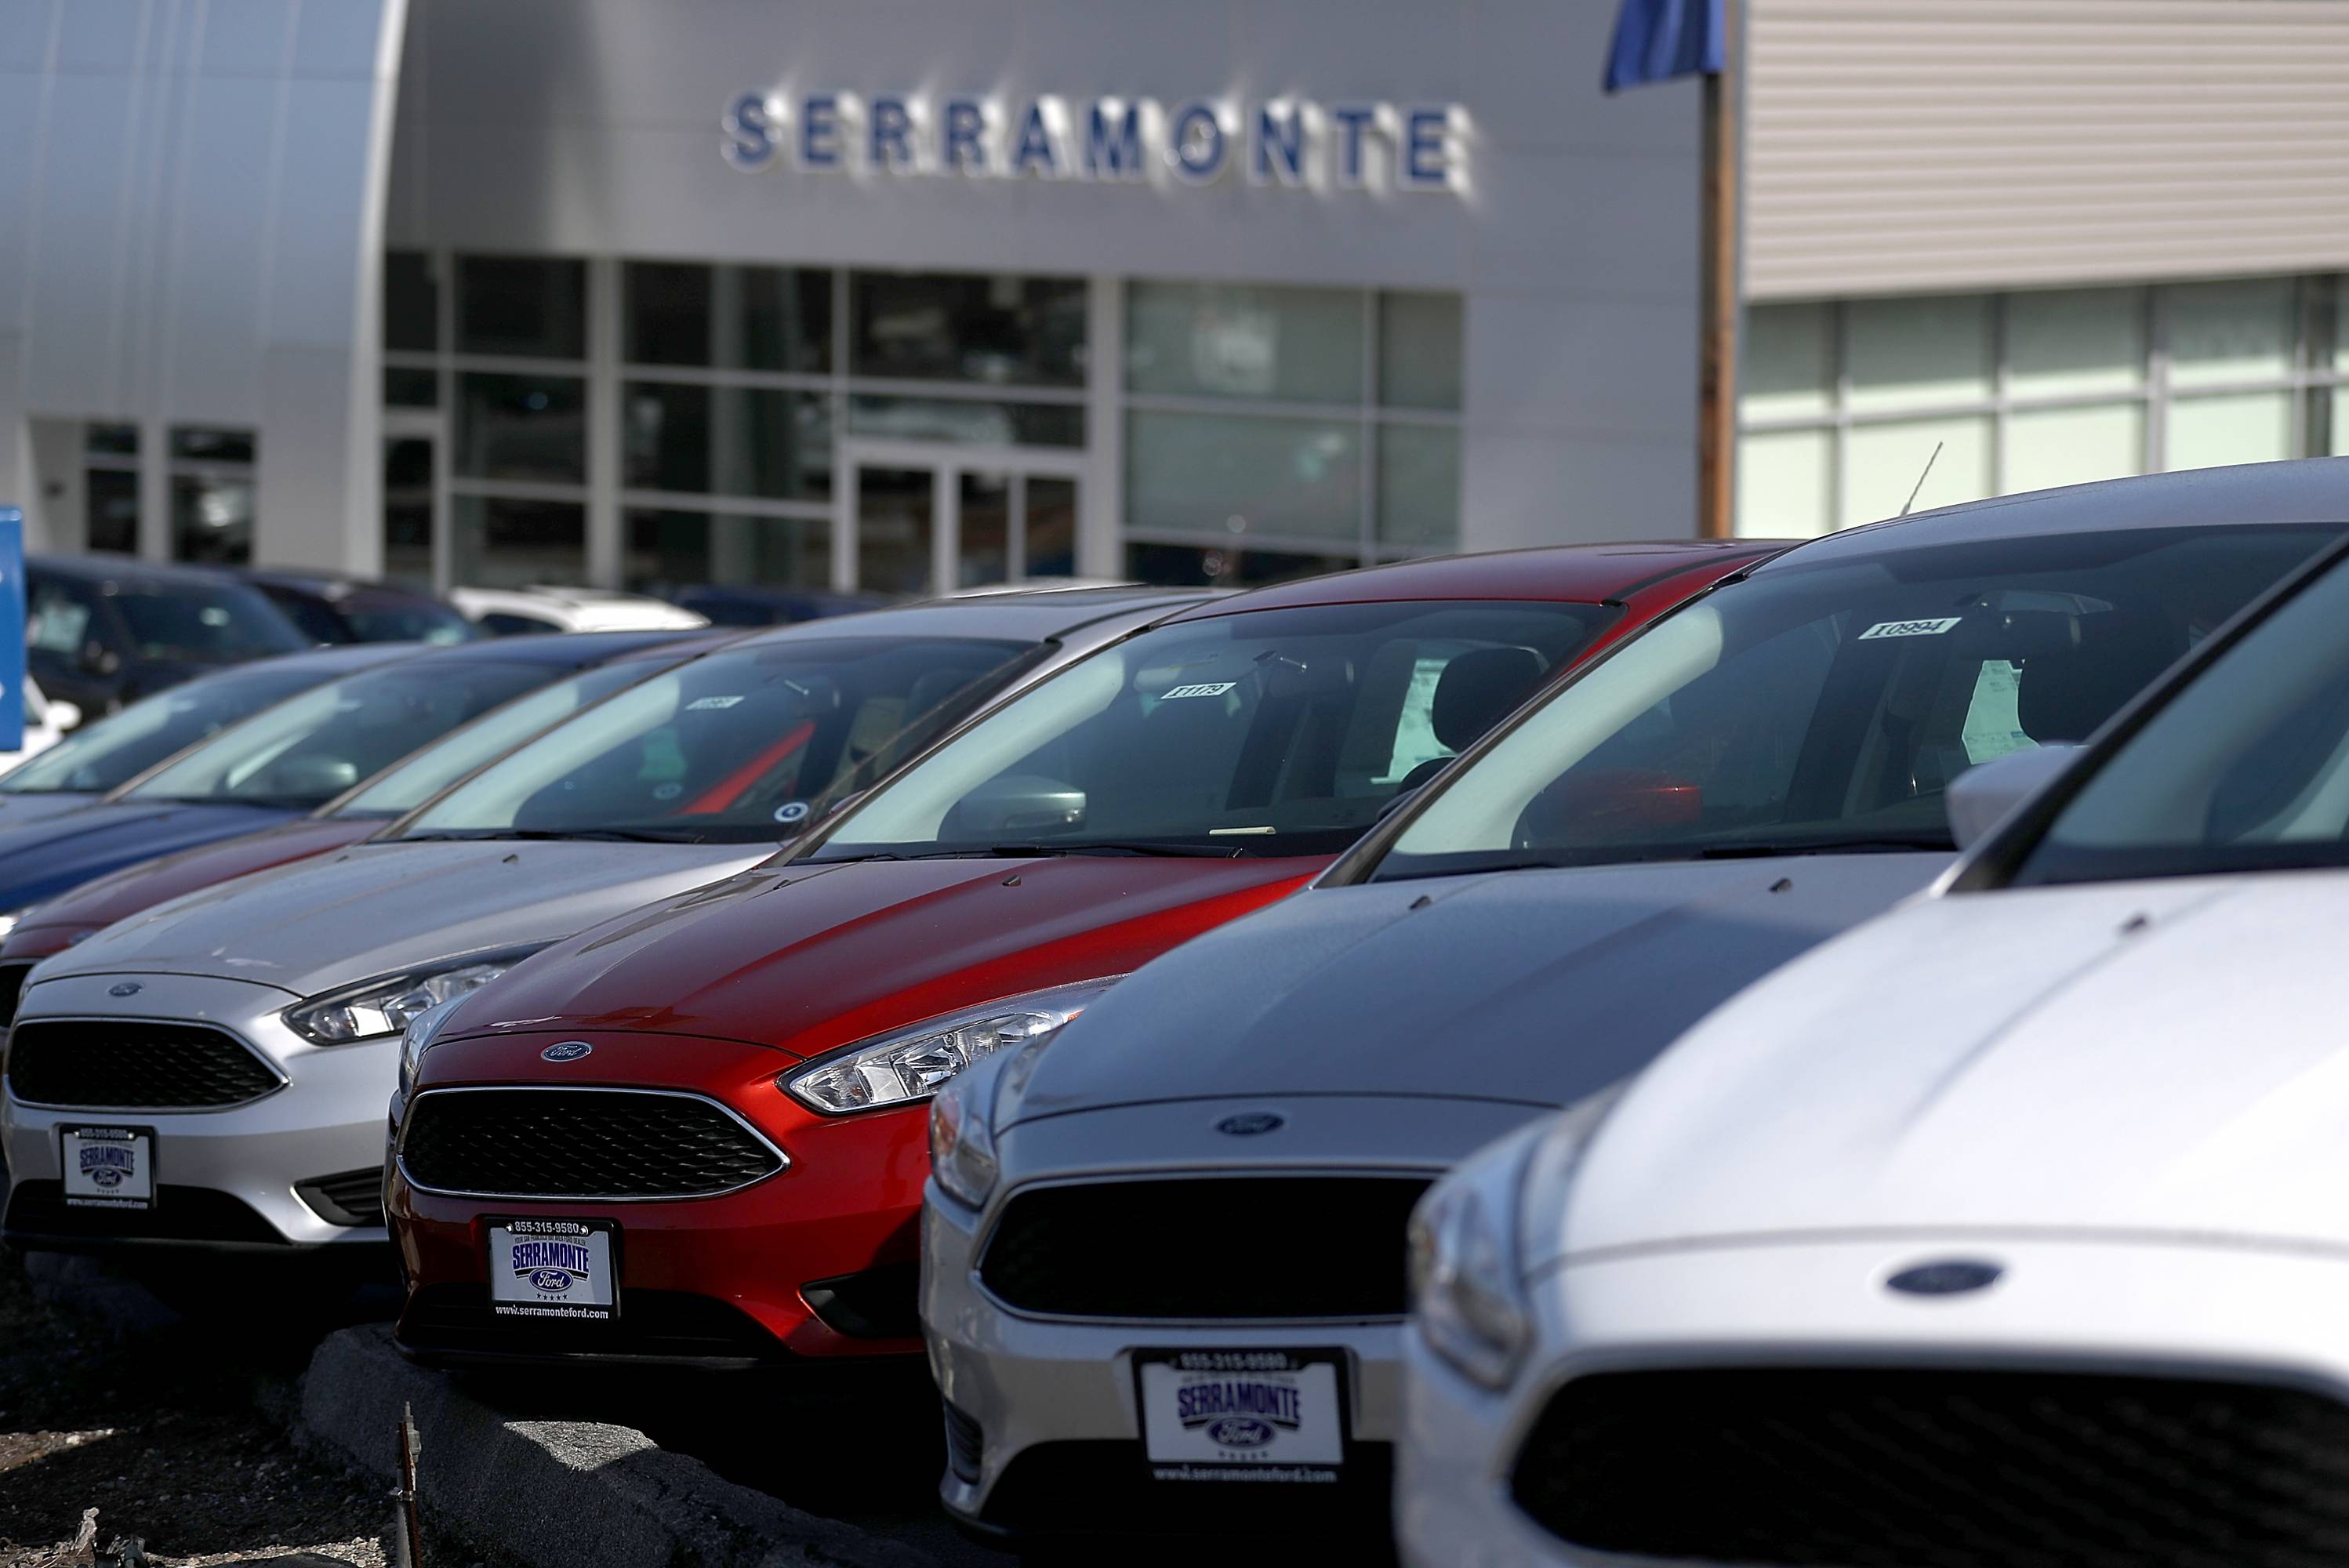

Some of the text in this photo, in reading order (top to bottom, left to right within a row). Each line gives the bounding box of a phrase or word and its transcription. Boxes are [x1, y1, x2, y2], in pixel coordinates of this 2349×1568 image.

[728, 91, 1457, 190] SERRAMONTE
[550, 1045, 582, 1057] Ford
[80, 1145, 134, 1171] SERRAMONTE
[514, 1221, 579, 1234] 855-315-9580
[512, 1242, 590, 1272] SERRAMONTE
[537, 1270, 565, 1287] Ford
[496, 1305, 608, 1319] www.serramonteford.com
[1178, 1382, 1301, 1421] SERRAMONTE
